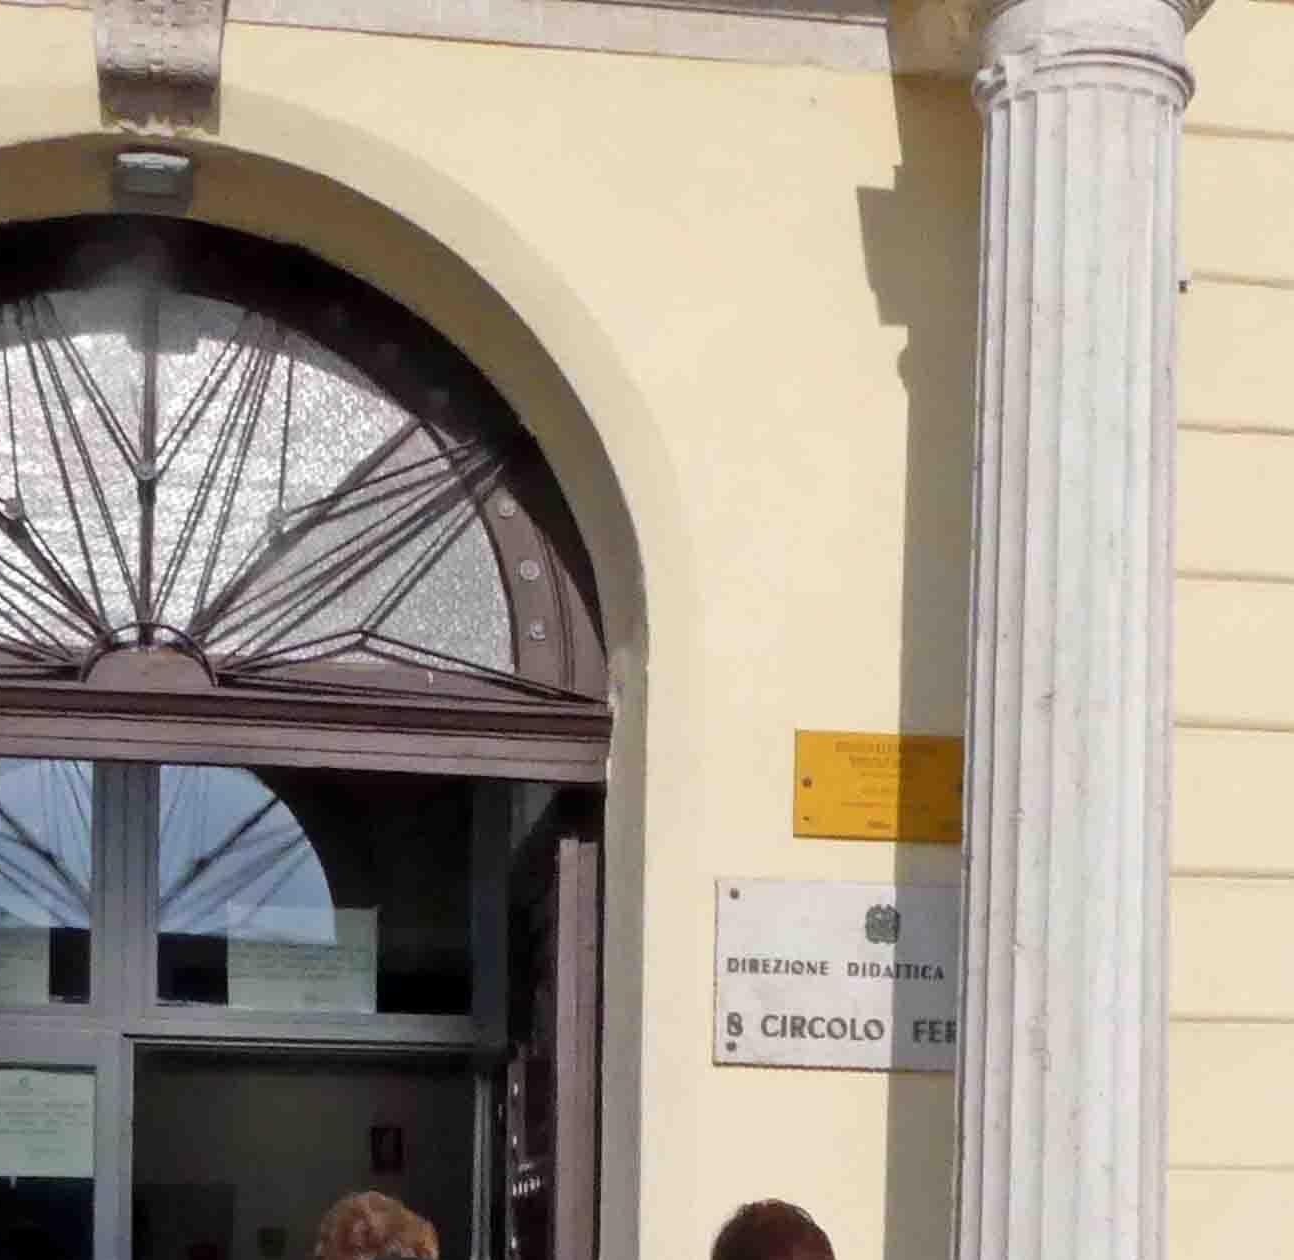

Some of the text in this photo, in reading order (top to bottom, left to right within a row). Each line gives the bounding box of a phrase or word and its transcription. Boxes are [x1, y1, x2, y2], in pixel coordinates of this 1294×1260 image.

[727, 957, 945, 981] DIREZIONE DIDATTICA
[760, 1014, 886, 1042] CIRCOLO
